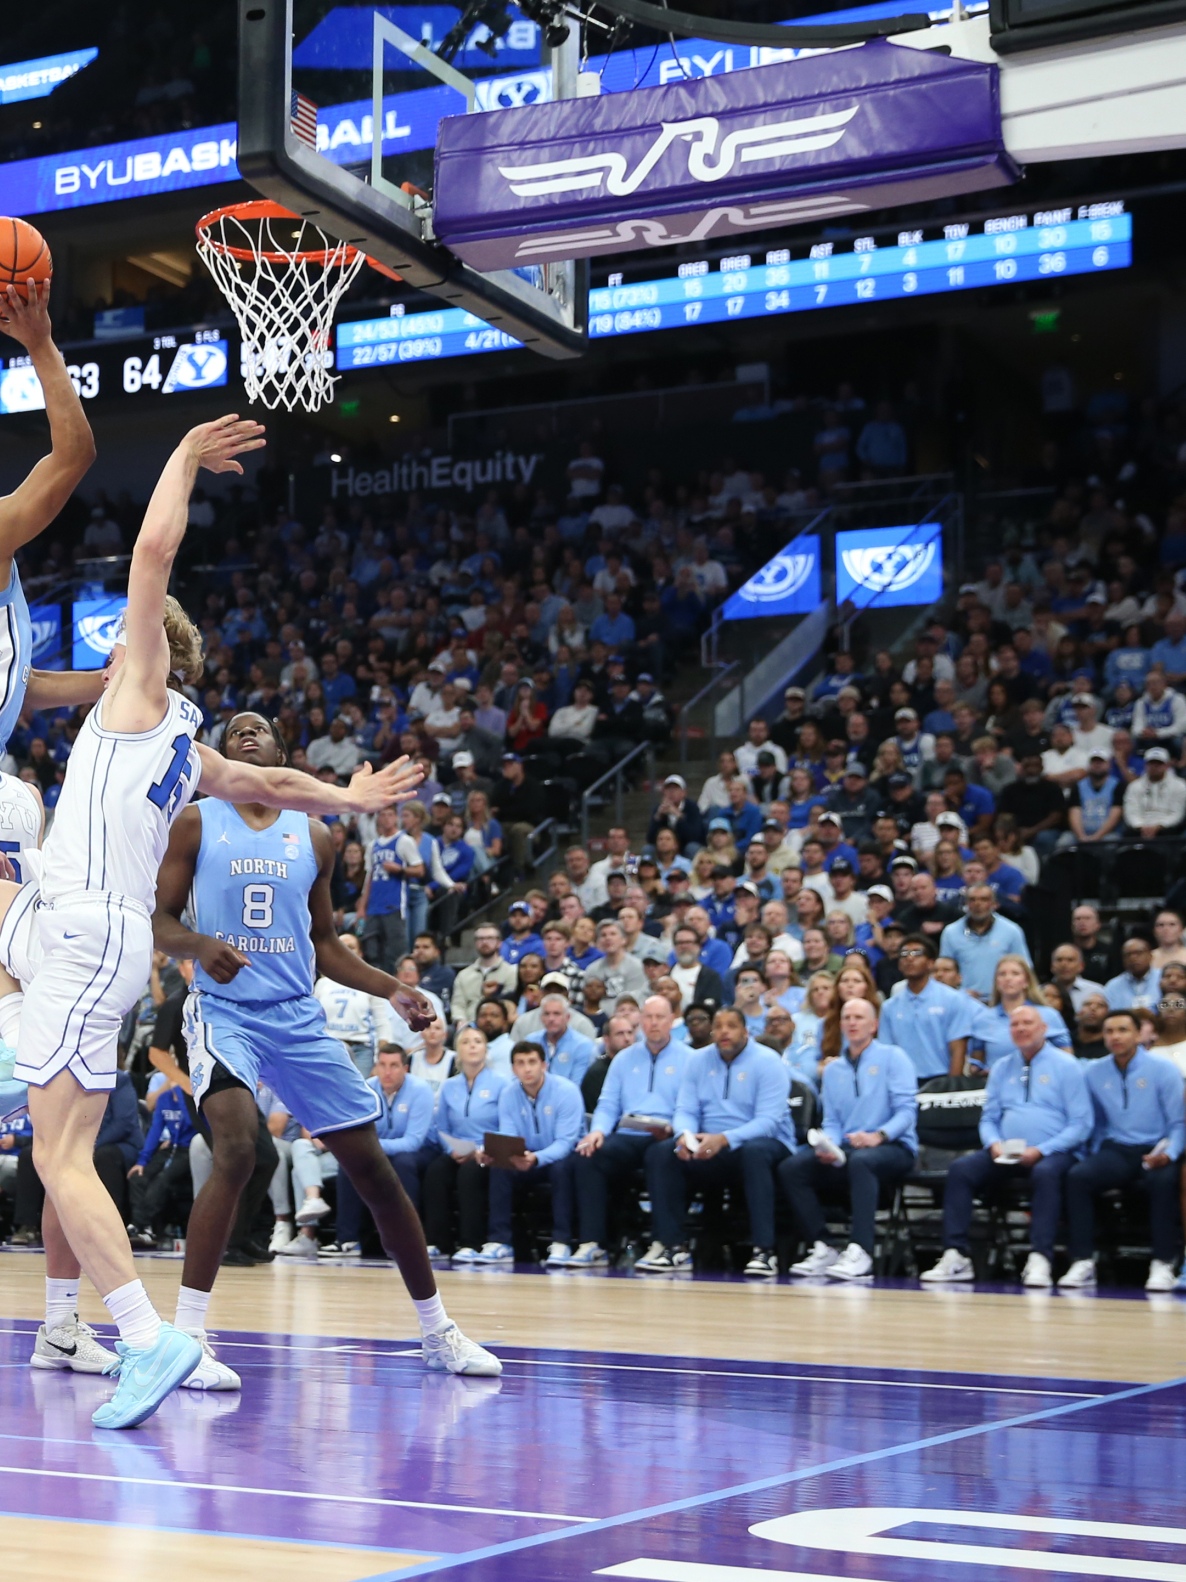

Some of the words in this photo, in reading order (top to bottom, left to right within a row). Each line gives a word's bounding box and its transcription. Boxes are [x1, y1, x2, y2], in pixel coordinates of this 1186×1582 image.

[984, 215, 1028, 235] BENCH
[722, 271, 748, 293] 20
[858, 254, 872, 274] 7
[902, 248, 918, 267] 4
[993, 233, 1017, 255] 10
[1038, 225, 1067, 249] 30
[683, 301, 704, 322] 17
[724, 295, 746, 316] 17
[765, 289, 790, 311] 34
[815, 284, 828, 305] 7
[855, 277, 876, 299] 12
[902, 272, 918, 293] 3
[946, 265, 965, 287] 11
[993, 258, 1017, 281] 10
[1038, 251, 1067, 275] 36
[1092, 245, 1109, 267] 6
[123, 354, 163, 393] 64
[331, 451, 537, 498] HealthEquity
[230, 858, 288, 879] NORTH
[242, 883, 274, 929] 8
[335, 999, 349, 1018] 7
